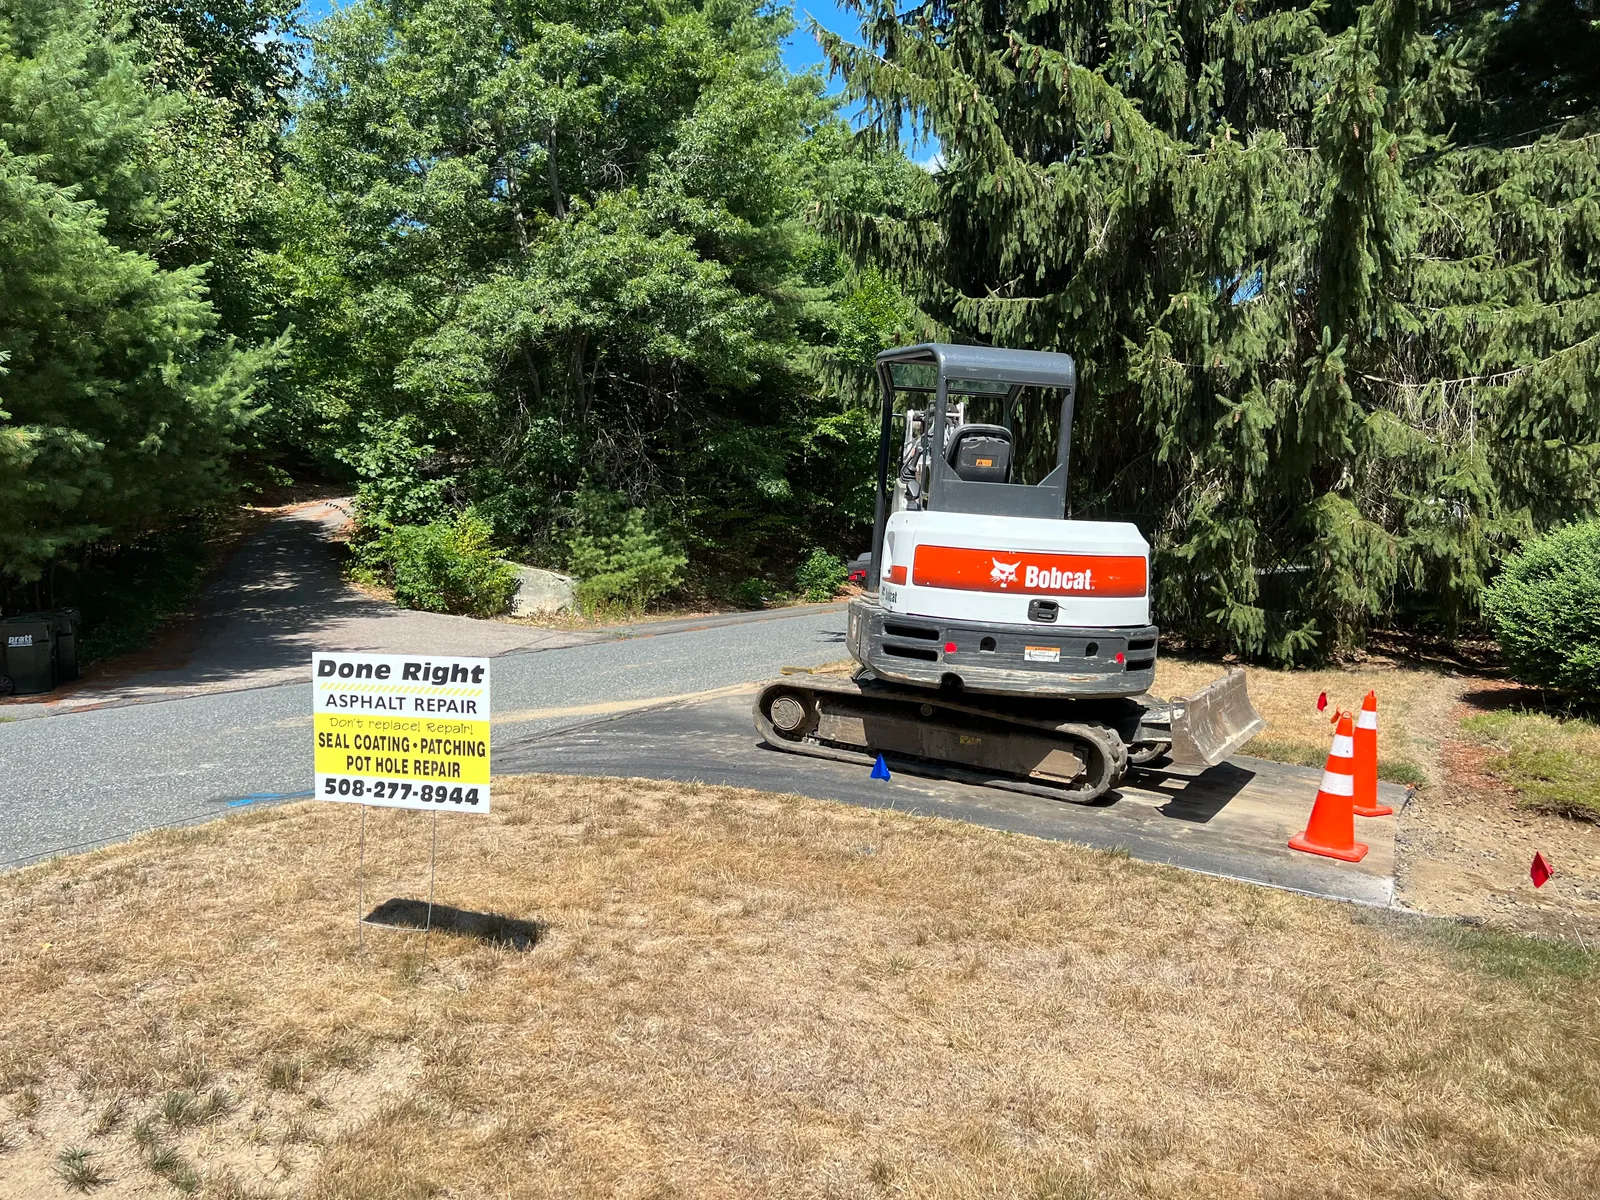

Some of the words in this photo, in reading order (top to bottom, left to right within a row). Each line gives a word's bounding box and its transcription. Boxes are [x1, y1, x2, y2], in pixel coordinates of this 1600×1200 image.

[1025, 565, 1092, 590] Bobcat
[8, 634, 33, 644] pratt
[317, 659, 391, 680] Done
[402, 662, 485, 686] Right
[325, 694, 407, 711] ASPHALT
[414, 698, 478, 714] REPAIR
[329, 717, 364, 729] Don't
[368, 719, 421, 732] replace!
[426, 723, 474, 735] Repair!
[318, 732, 350, 749] SEAL
[354, 734, 410, 753] COATING
[420, 738, 486, 758] PATCHING
[346, 755, 371, 772] POT
[375, 757, 409, 775] HOLE
[413, 759, 461, 778] REPAIR
[324, 777, 479, 806] 508-277-8944
